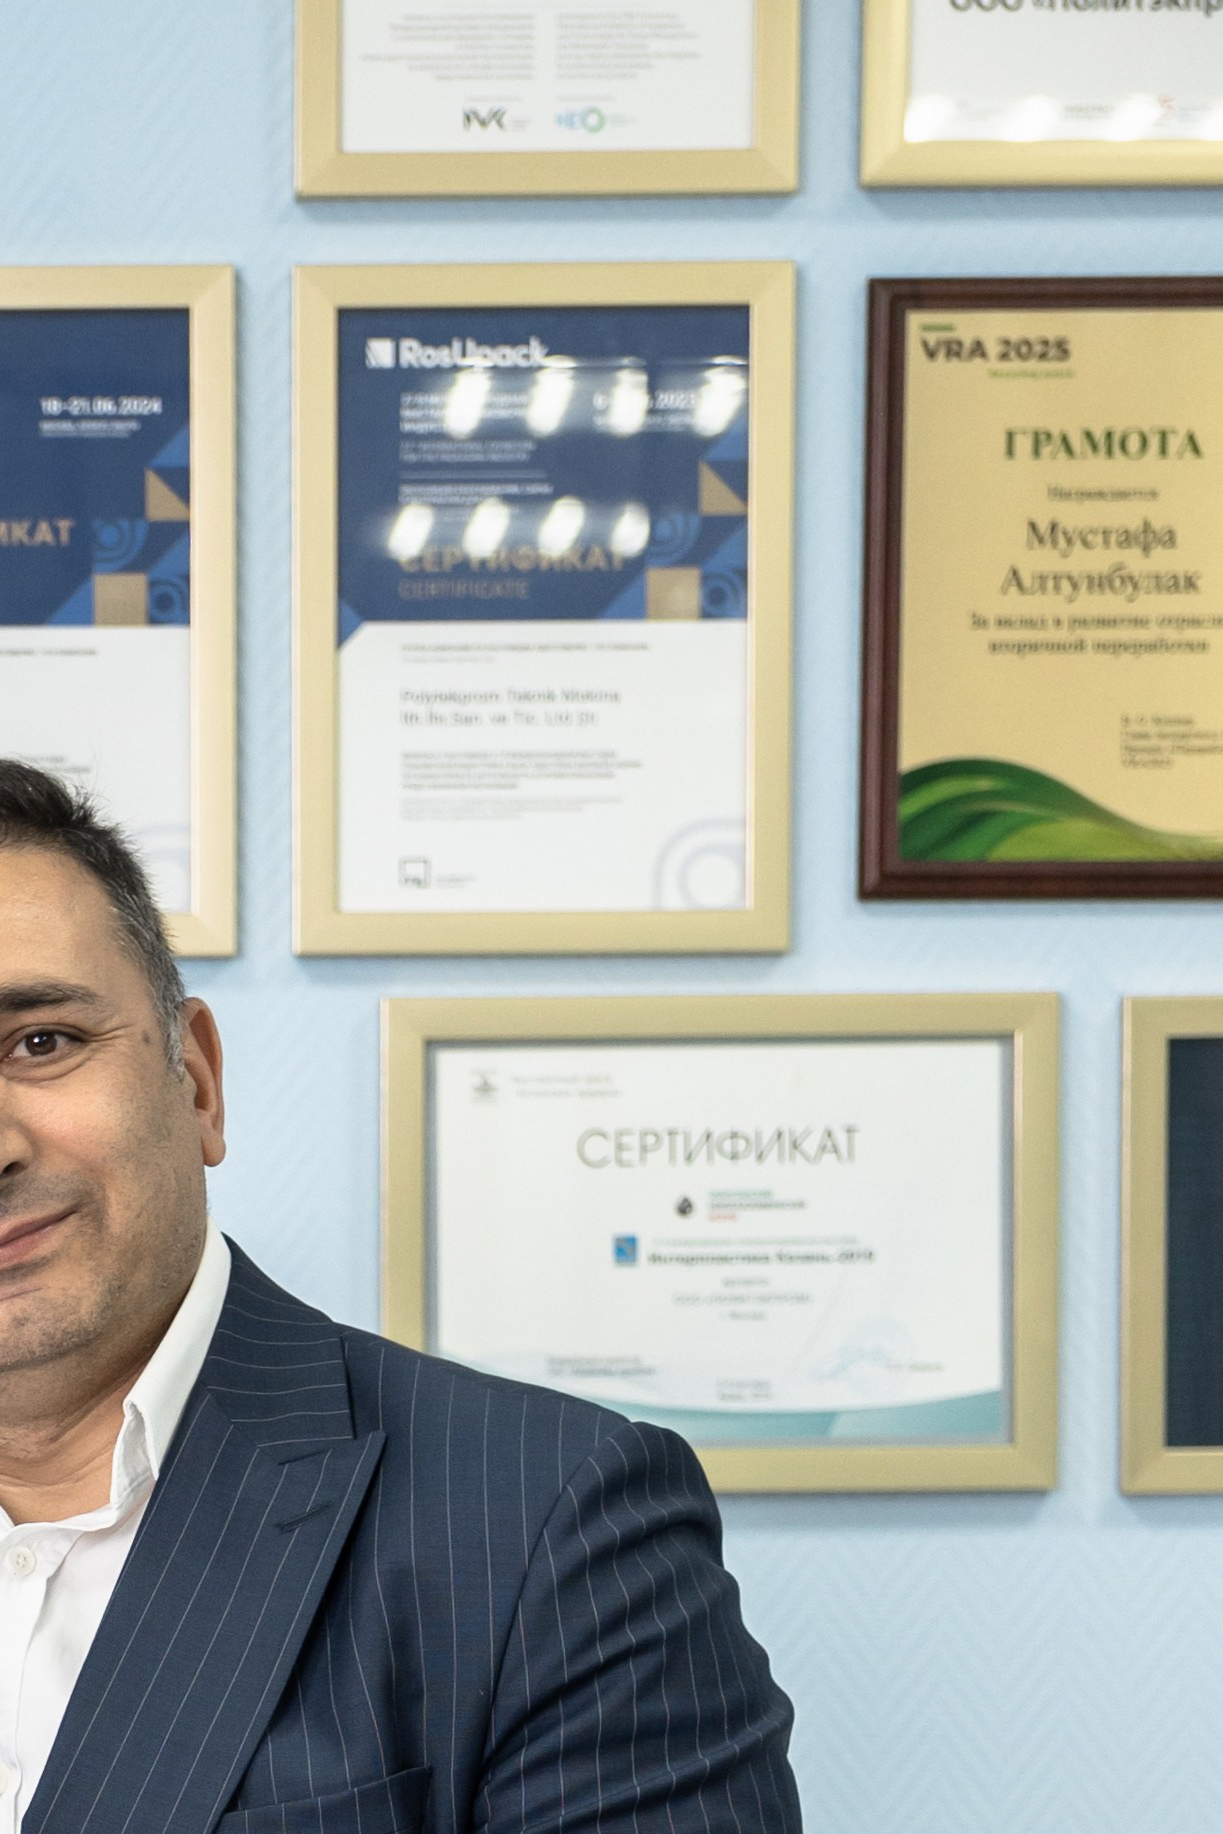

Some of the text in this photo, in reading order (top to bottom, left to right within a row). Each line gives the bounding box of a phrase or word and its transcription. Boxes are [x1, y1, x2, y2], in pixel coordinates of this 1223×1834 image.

[920, 334, 1071, 363] VRA 2025
[1004, 427, 1205, 461] ГРАМОТА
[1026, 516, 1178, 558] Мустафа
[999, 561, 1203, 603] Алтунбулак
[575, 1124, 861, 1170] СЕРТИФИКАТ
